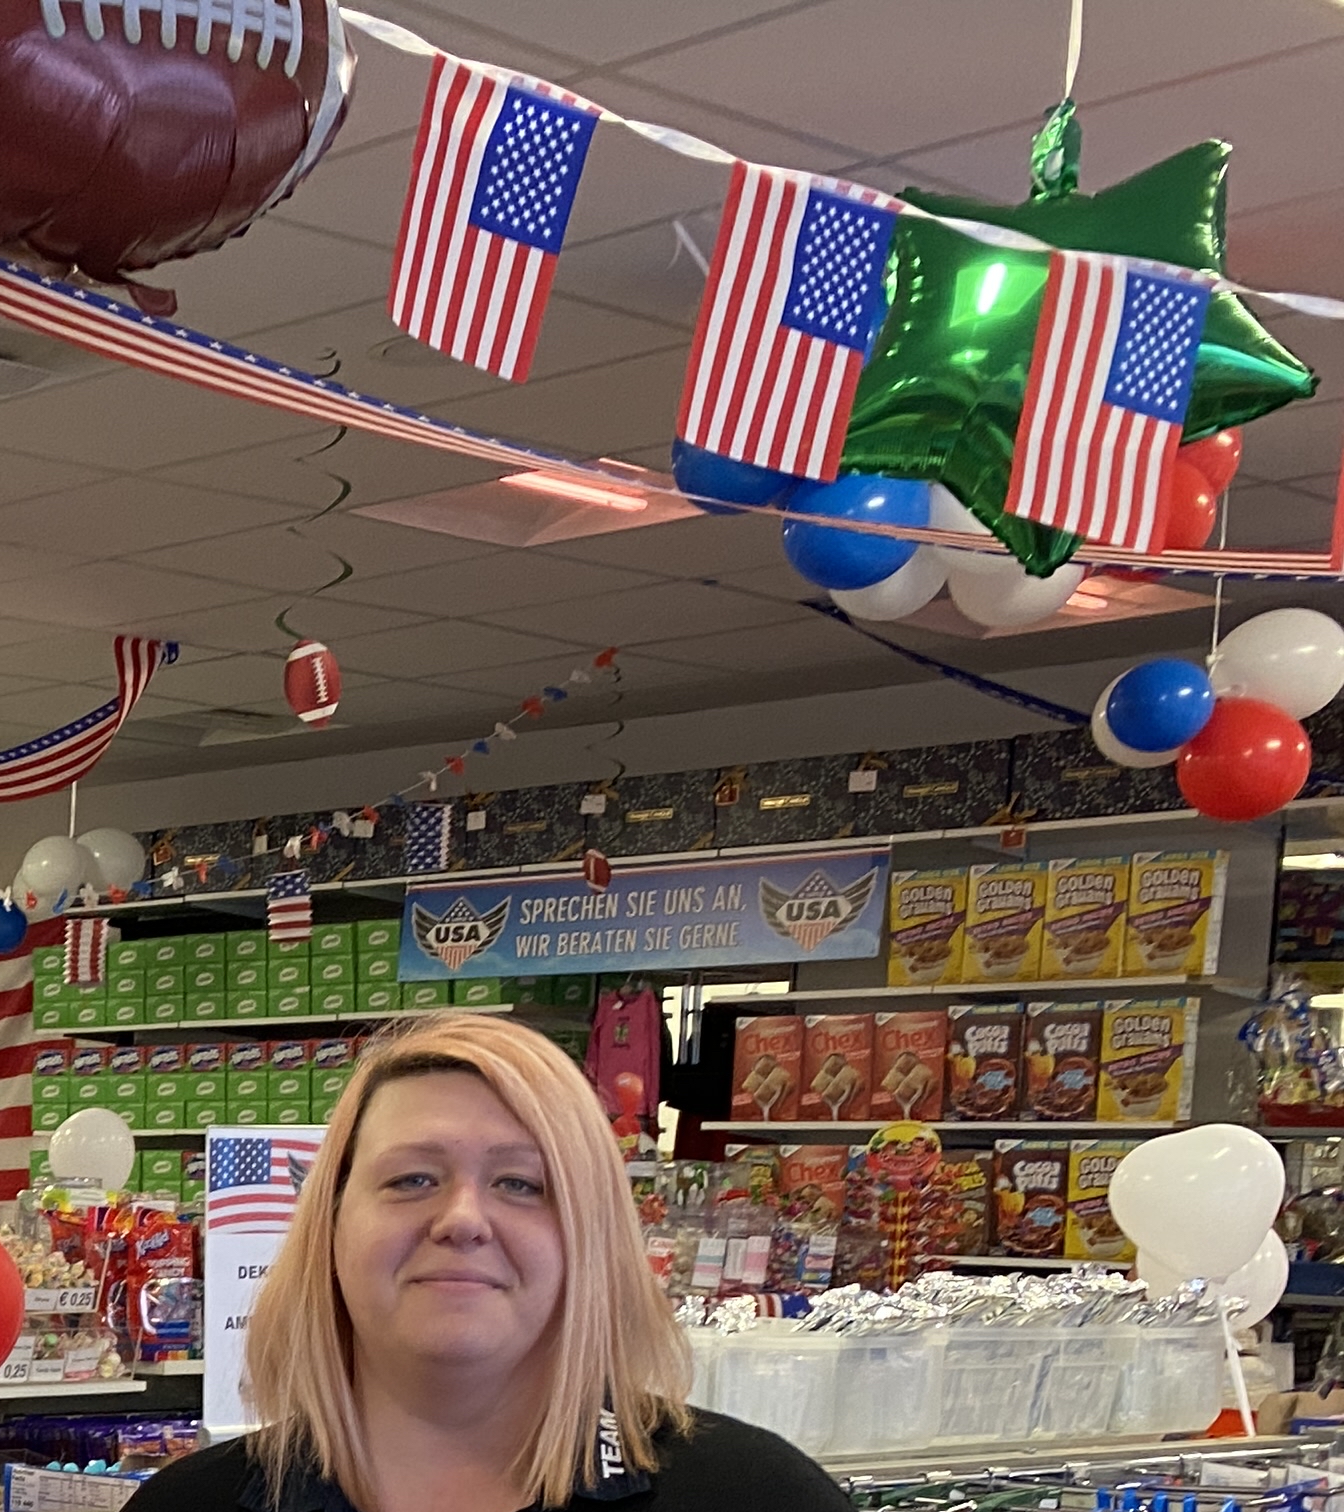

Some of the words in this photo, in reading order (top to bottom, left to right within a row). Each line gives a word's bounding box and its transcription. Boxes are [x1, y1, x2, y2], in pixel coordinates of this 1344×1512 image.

[519, 894, 617, 925] SPRECHEN
[625, 890, 656, 919] SIE
[664, 888, 704, 914] UNS
[713, 884, 747, 913] AN,
[784, 900, 843, 922] USA
[434, 921, 480, 944] USA
[515, 933, 549, 959] WIR
[556, 929, 636, 956] BERATEN
[645, 926, 673, 952] SIE
[59, 1293, 68, 1306] €
[599, 1408, 625, 1478] TEAM
